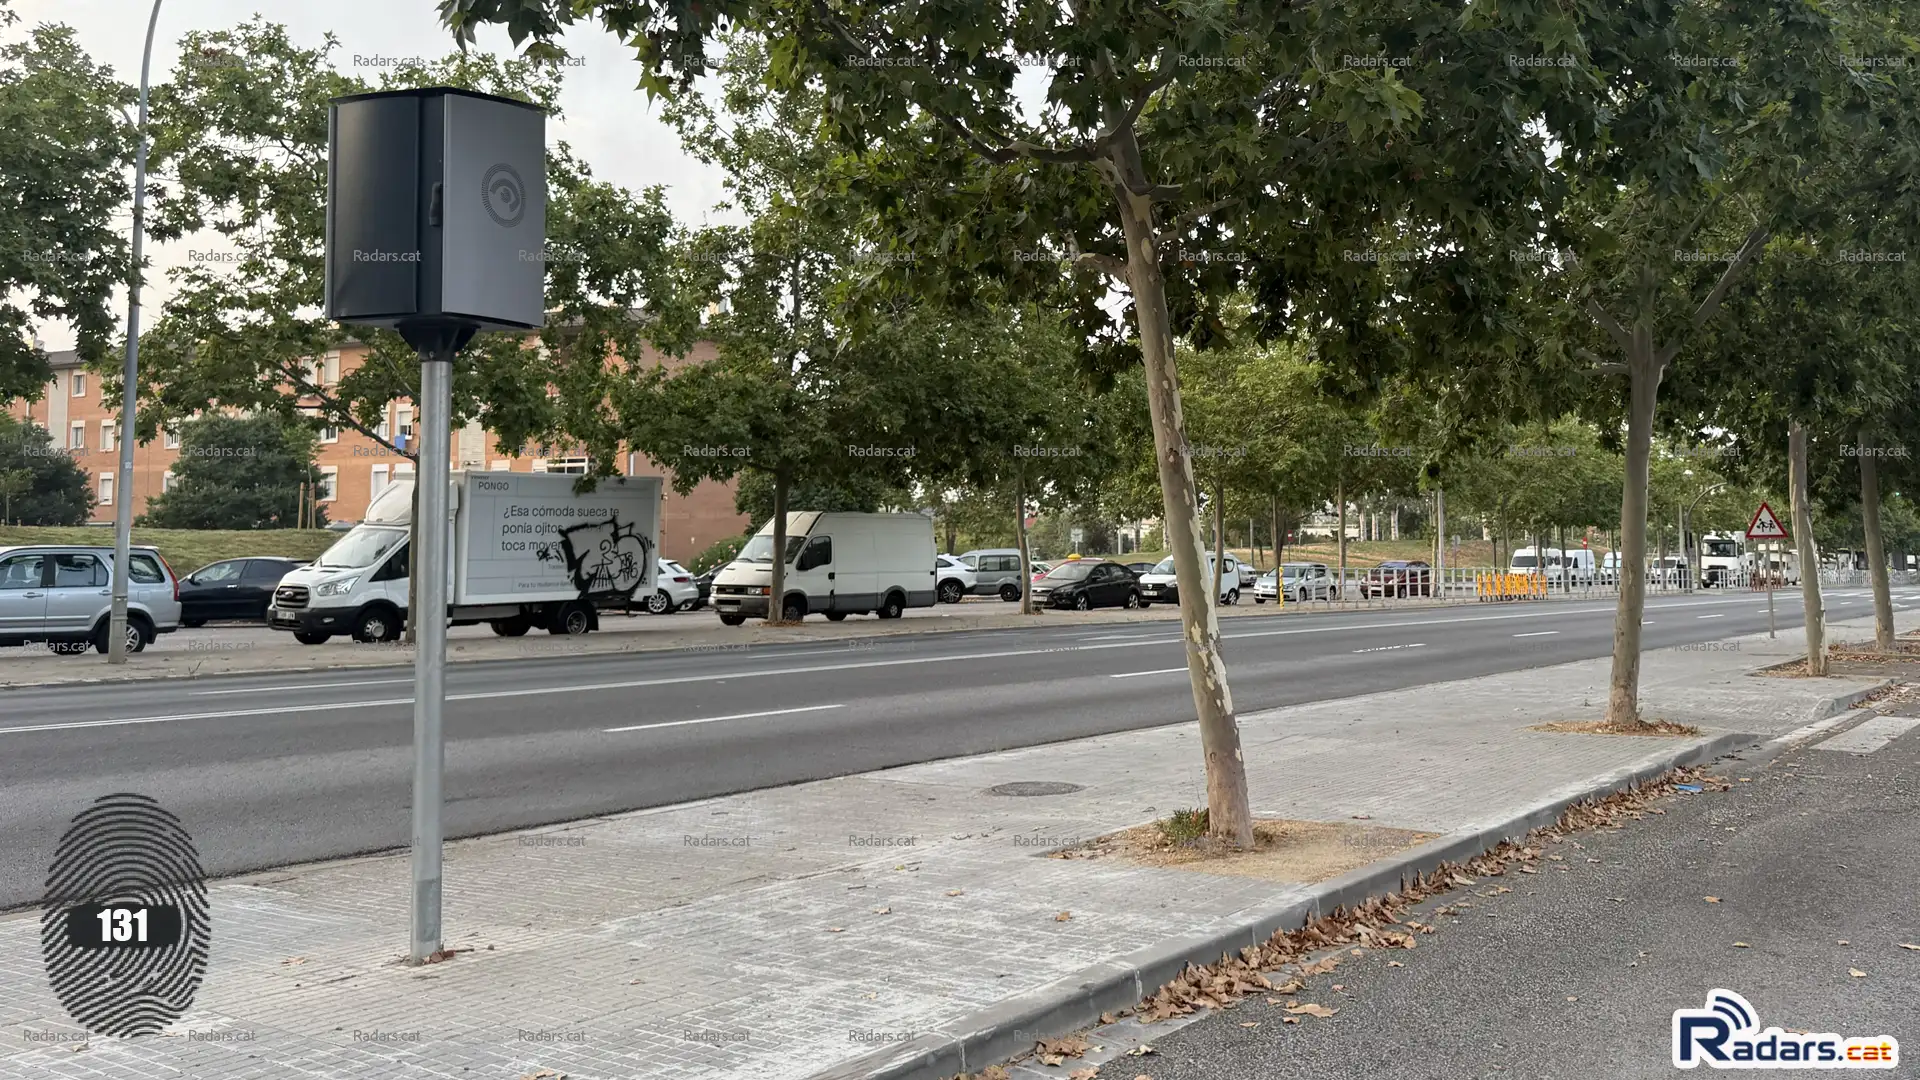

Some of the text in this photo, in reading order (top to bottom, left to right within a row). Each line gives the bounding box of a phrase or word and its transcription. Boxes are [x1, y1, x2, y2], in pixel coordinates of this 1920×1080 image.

[478, 481, 509, 491] PONGO
[503, 505, 619, 519] ¿Esa cómoda sueca te
[502, 522, 532, 536] ponía
[501, 540, 525, 551] toca
